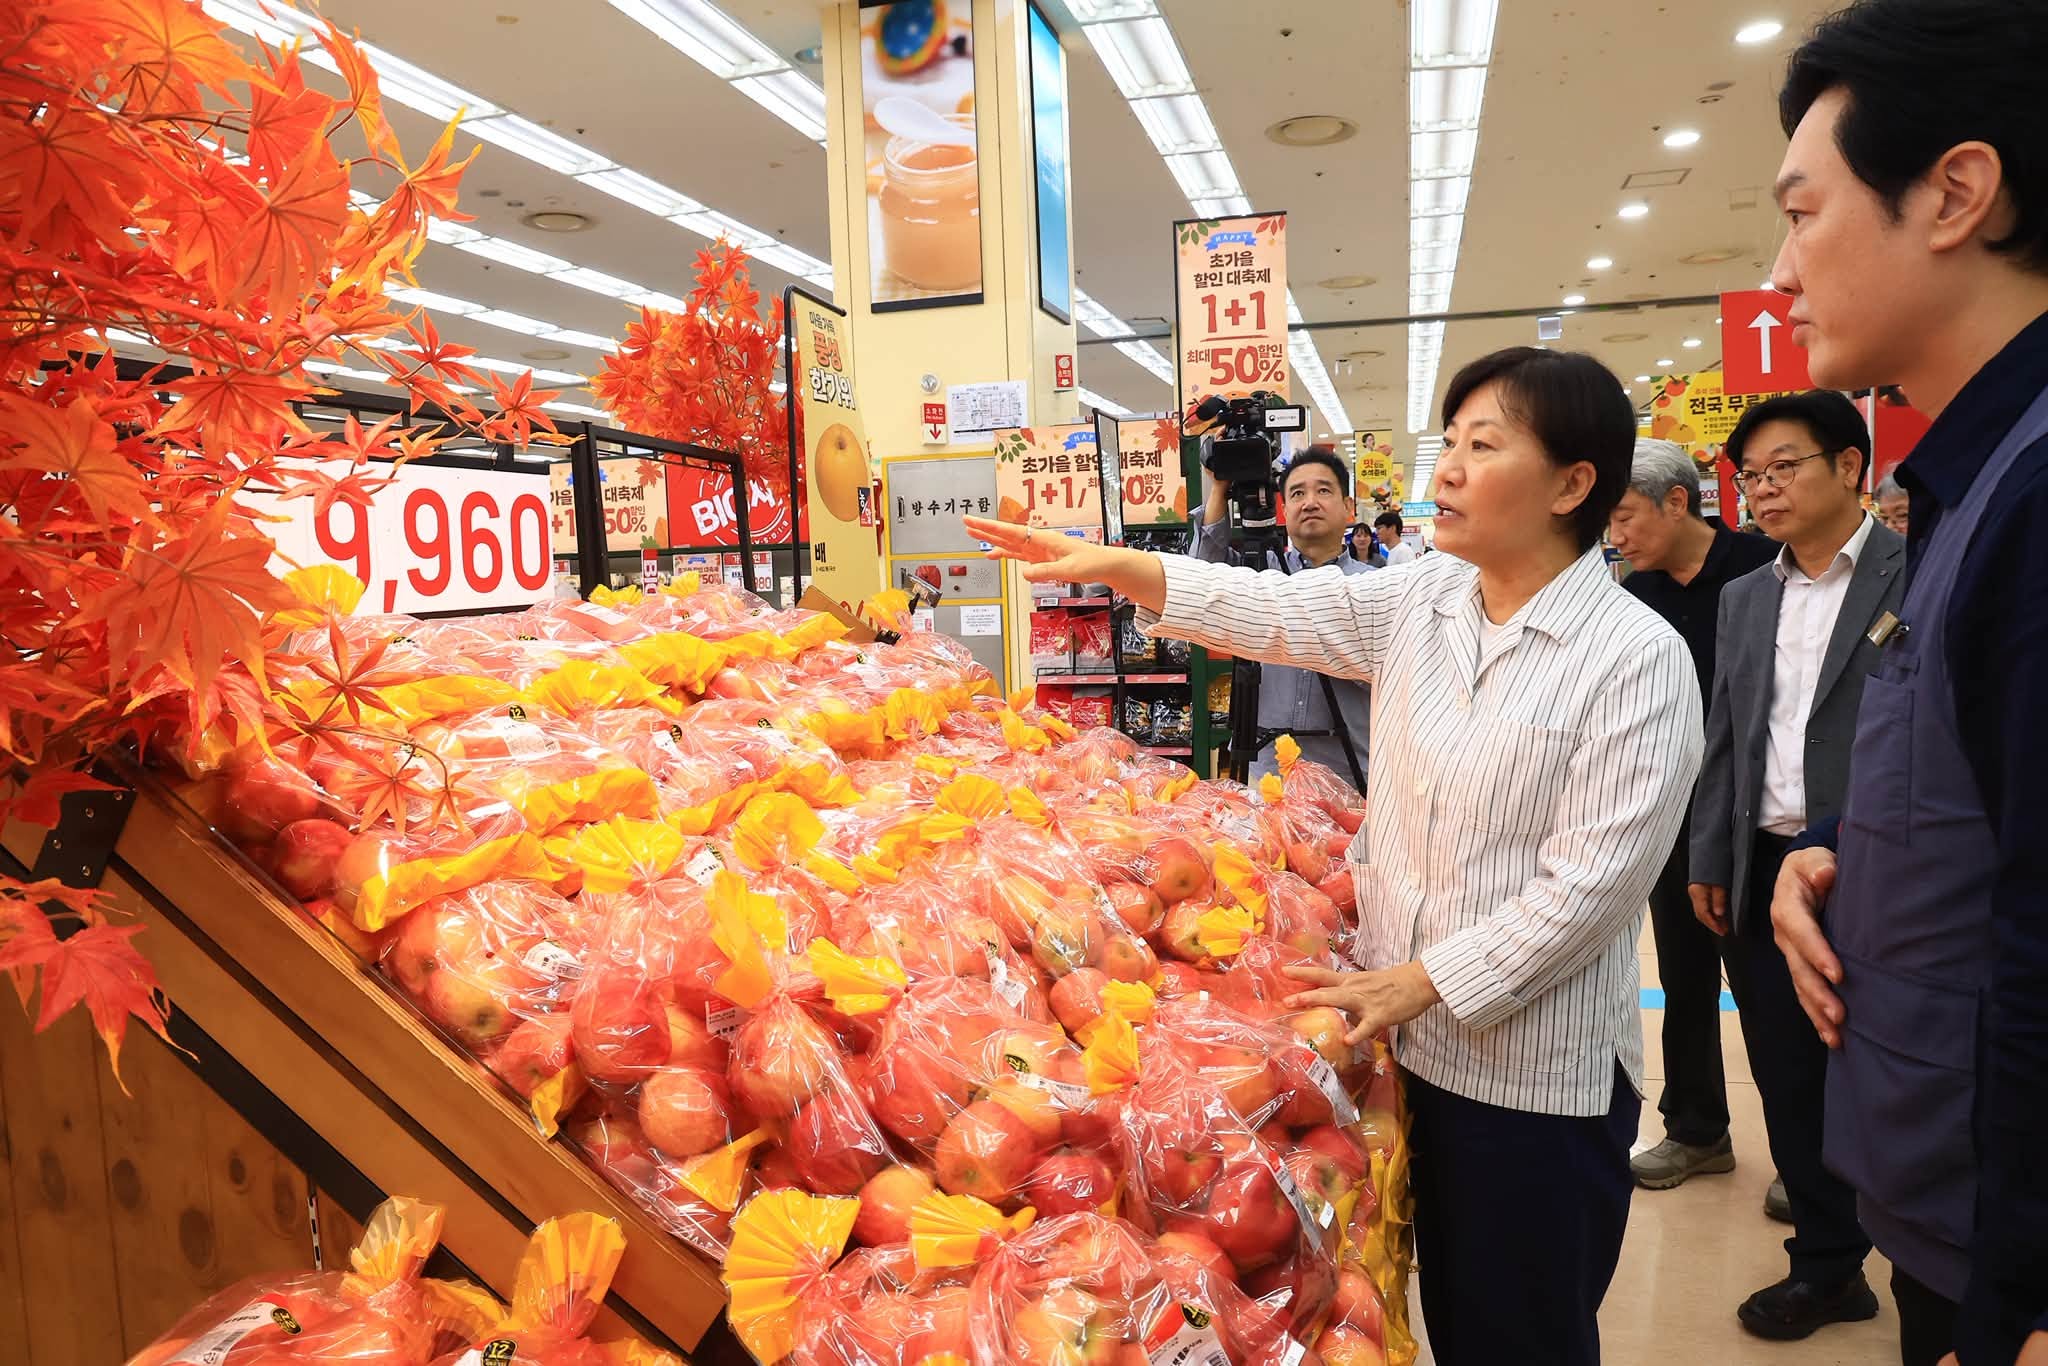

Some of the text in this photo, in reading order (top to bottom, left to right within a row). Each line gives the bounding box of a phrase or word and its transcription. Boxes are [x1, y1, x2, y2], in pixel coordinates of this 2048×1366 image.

[1210, 251, 1254, 269] 초가을
[1194, 268, 1271, 289] 할인 대축제
[1201, 290, 1266, 333] 1+1
[1187, 344, 1285, 386] 최대 50% 할인
[809, 367, 856, 411] 한가위
[1690, 396, 1723, 415] 전국
[1073, 432, 1096, 442] HAP
[1022, 455, 1072, 474] 초가을
[1144, 473, 1164, 485] 할인
[605, 485, 645, 502] 대축제
[911, 497, 991, 516] 방수기구함
[314, 487, 550, 613] 9,960
[814, 542, 826, 563] 배
[489, 1343, 509, 1359] 12
